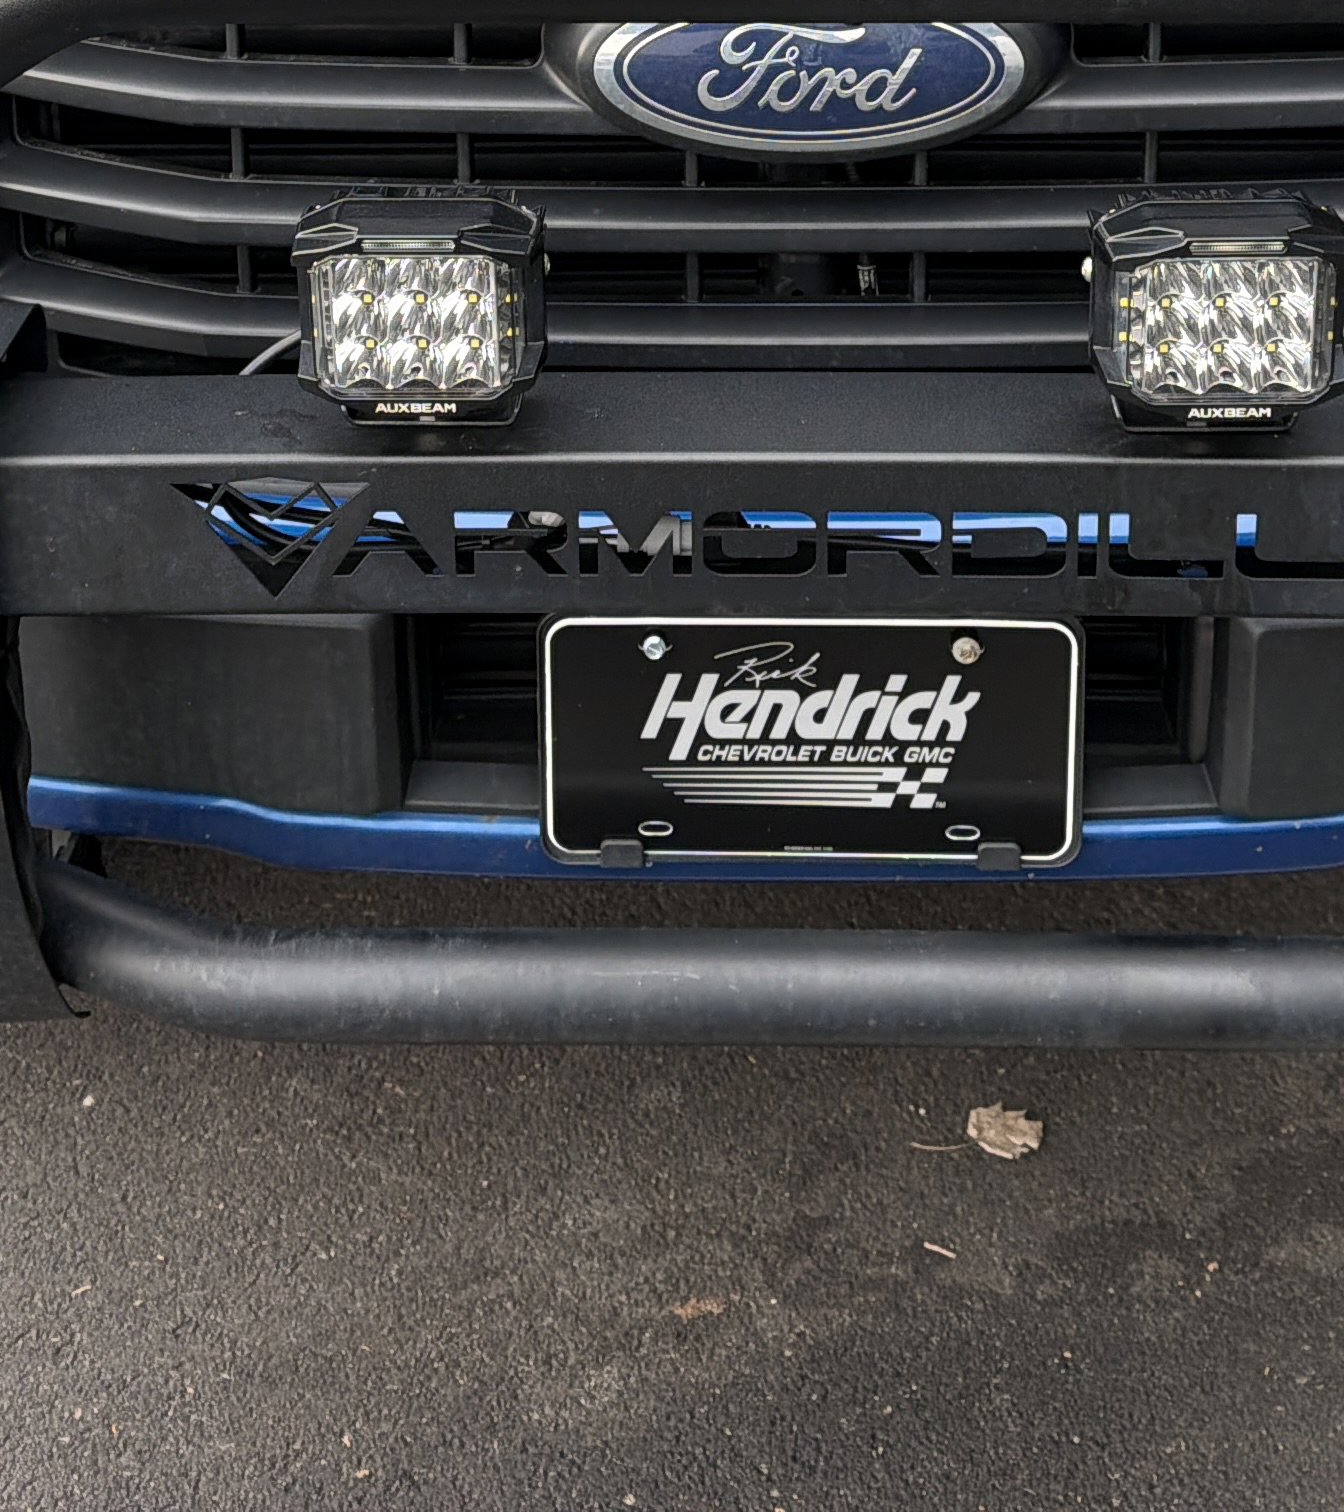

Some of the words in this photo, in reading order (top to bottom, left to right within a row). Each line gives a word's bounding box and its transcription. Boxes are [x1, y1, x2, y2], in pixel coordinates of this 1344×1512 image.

[696, 23, 923, 113] Ford
[375, 402, 457, 414] AUXBEAM
[1187, 407, 1272, 419] AUXBEAM
[640, 673, 981, 761] Hendrick
[696, 744, 826, 763] CHEVROLET
[829, 745, 899, 764] BUICK
[902, 747, 956, 765] GMC
